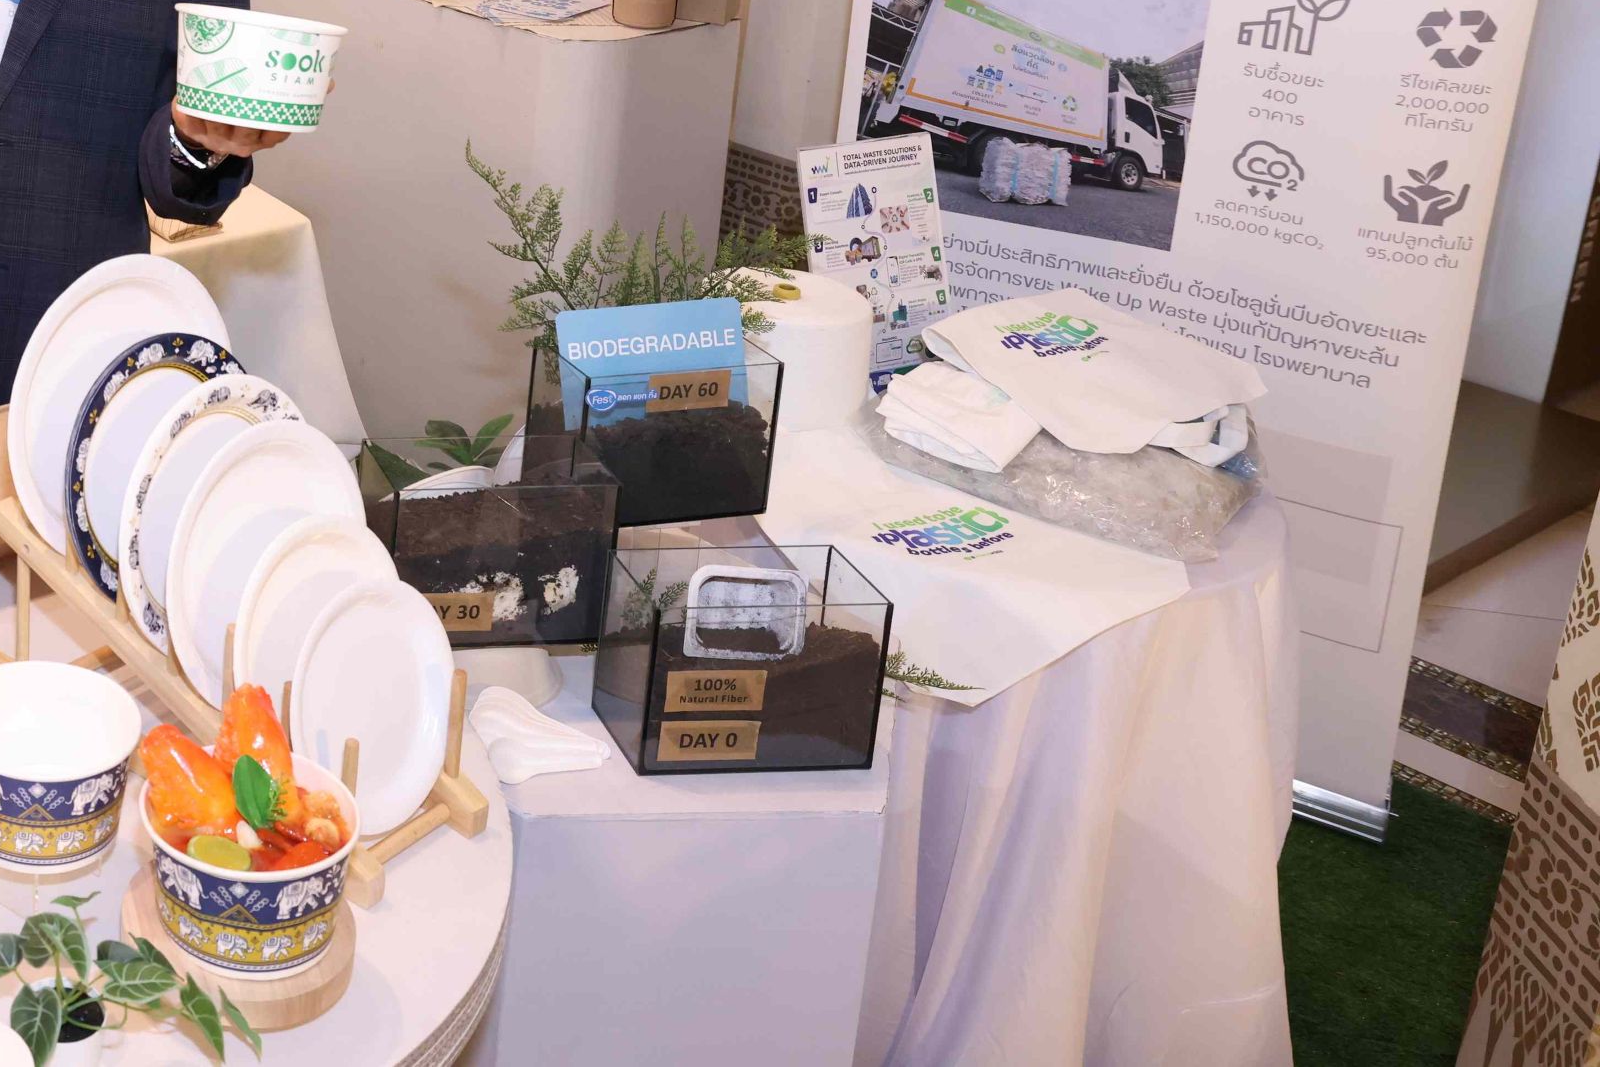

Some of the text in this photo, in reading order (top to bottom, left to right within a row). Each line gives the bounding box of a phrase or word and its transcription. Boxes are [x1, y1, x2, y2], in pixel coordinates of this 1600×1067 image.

[270, 72, 315, 85] SIAM
[1243, 61, 1325, 89] รับซื้อขยะ
[1400, 73, 1494, 96] รีไซเคิลขยะ
[1262, 89, 1298, 105] 400
[1395, 95, 1490, 115] 2,000,000
[1248, 106, 1305, 127] อาคาร
[1405, 113, 1474, 133] กิโลกรัม
[843, 153, 861, 162] TOTAL
[863, 150, 883, 159] WASTE
[883, 146, 916, 156] SOLUTIONS
[844, 159, 887, 170] DATA-DRIVEN
[889, 153, 918, 164] JOURNEY
[926, 191, 933, 200] 2
[1214, 198, 1304, 226] ลดคาร์บอน
[1194, 211, 1270, 237] 1,150,000
[1357, 226, 1474, 252] แทนปลูกต้นไม้
[933, 249, 939, 258] 4
[1365, 246, 1459, 269] 95,000 ต้น
[939, 293, 945, 302] 6
[1117, 291, 1142, 312] Up
[1149, 297, 1208, 324] Waste
[567, 328, 737, 361] BIODEGRADABLE
[1253, 345, 1371, 389] โรงพยาบาล
[659, 381, 719, 401] DAY 60
[882, 515, 924, 530] used
[967, 531, 1014, 550] before
[457, 605, 480, 620] 30
[694, 678, 737, 692] 100%
[679, 694, 748, 704] Natural Fiber
[679, 732, 738, 749] DAY 0
